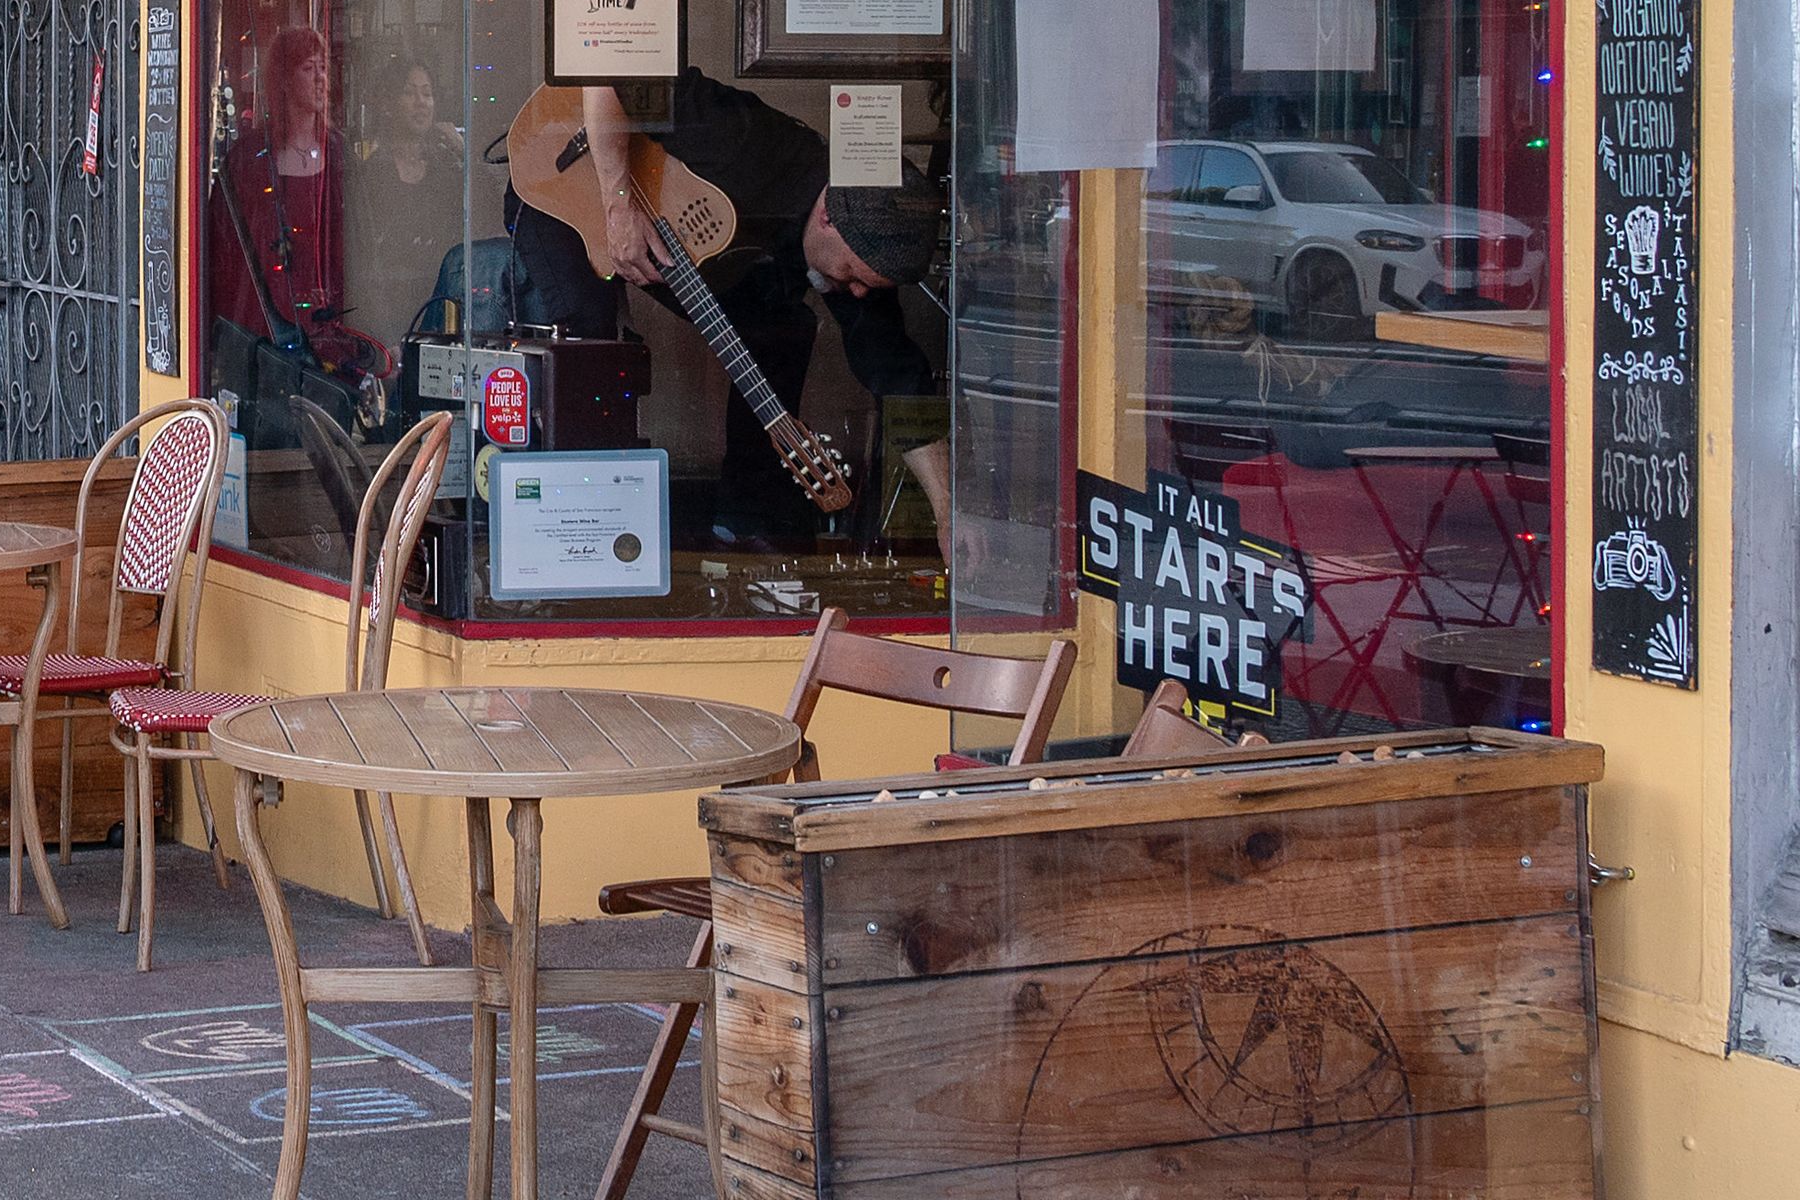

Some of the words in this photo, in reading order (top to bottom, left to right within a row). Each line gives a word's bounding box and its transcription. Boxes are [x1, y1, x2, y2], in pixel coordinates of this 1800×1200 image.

[1601, 40, 1684, 95] NATURAL
[1615, 99, 1675, 150] VEGAN
[1618, 153, 1677, 198] WINES
[490, 394, 509, 406] LOVE
[511, 394, 522, 406] US
[491, 381, 521, 394] PEOPLE
[492, 413, 512, 423] yelp
[1612, 384, 1672, 448] LOCAL
[1158, 483, 1179, 516] IT
[1186, 495, 1229, 536] ALL
[1601, 448, 1690, 521] ARTISTS
[1090, 496, 1305, 618] STARTS
[1124, 601, 1266, 700] HERE
